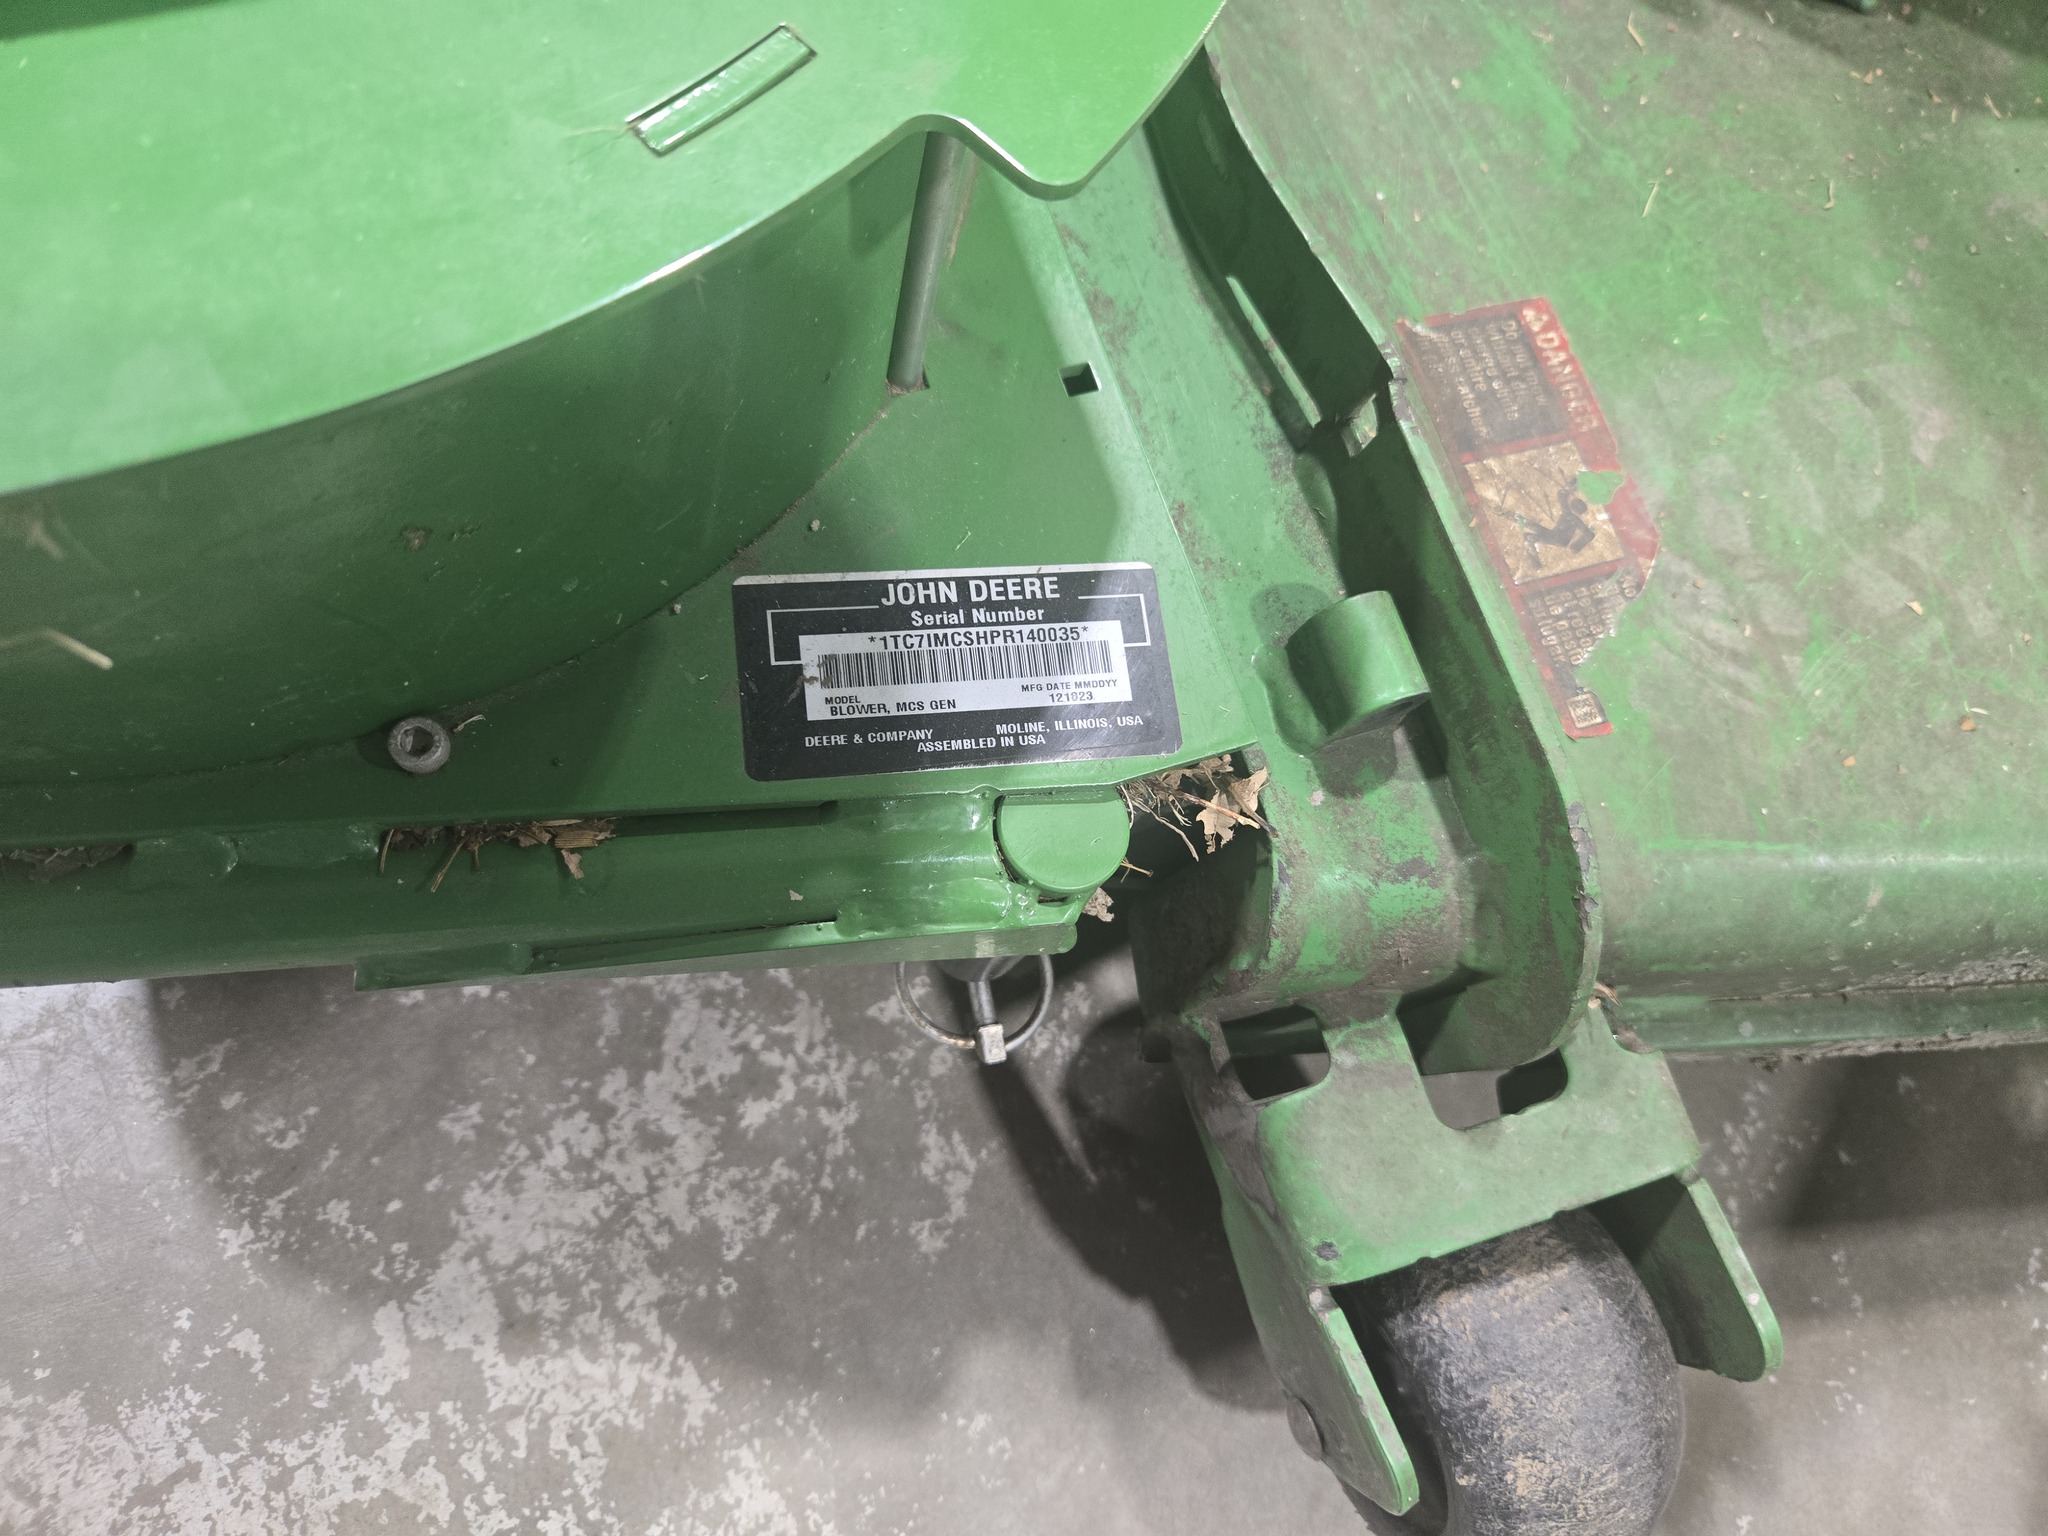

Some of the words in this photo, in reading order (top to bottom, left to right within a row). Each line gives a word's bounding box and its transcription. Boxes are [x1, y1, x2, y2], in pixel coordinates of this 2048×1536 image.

[1501, 320, 1518, 340] Do
[1450, 330, 1468, 347] or
[1459, 348, 1487, 392] entire
[1536, 331, 1598, 432] DANGER
[881, 580, 958, 606] JOHN
[969, 577, 1060, 602] DEERE
[911, 609, 964, 626] Serial
[972, 607, 1044, 624] Number
[1021, 683, 1043, 692] MFG
[1046, 682, 1071, 691] DATE
[1074, 679, 1117, 690] MMDDYY
[825, 695, 861, 705] MODEL
[830, 703, 891, 716] BLOWER,
[896, 701, 925, 712] MCS
[930, 699, 956, 710] GEN
[995, 721, 1050, 735] MOLINE,
[1054, 717, 1113, 731] ILLINOIS,
[1117, 715, 1143, 728] USA
[805, 734, 848, 747] DEERE
[853, 733, 863, 744] &
[868, 729, 933, 743] COMPANY
[917, 737, 996, 752] ASSEMBLED
[1001, 736, 1014, 747] IN
[1019, 734, 1046, 745] USA
